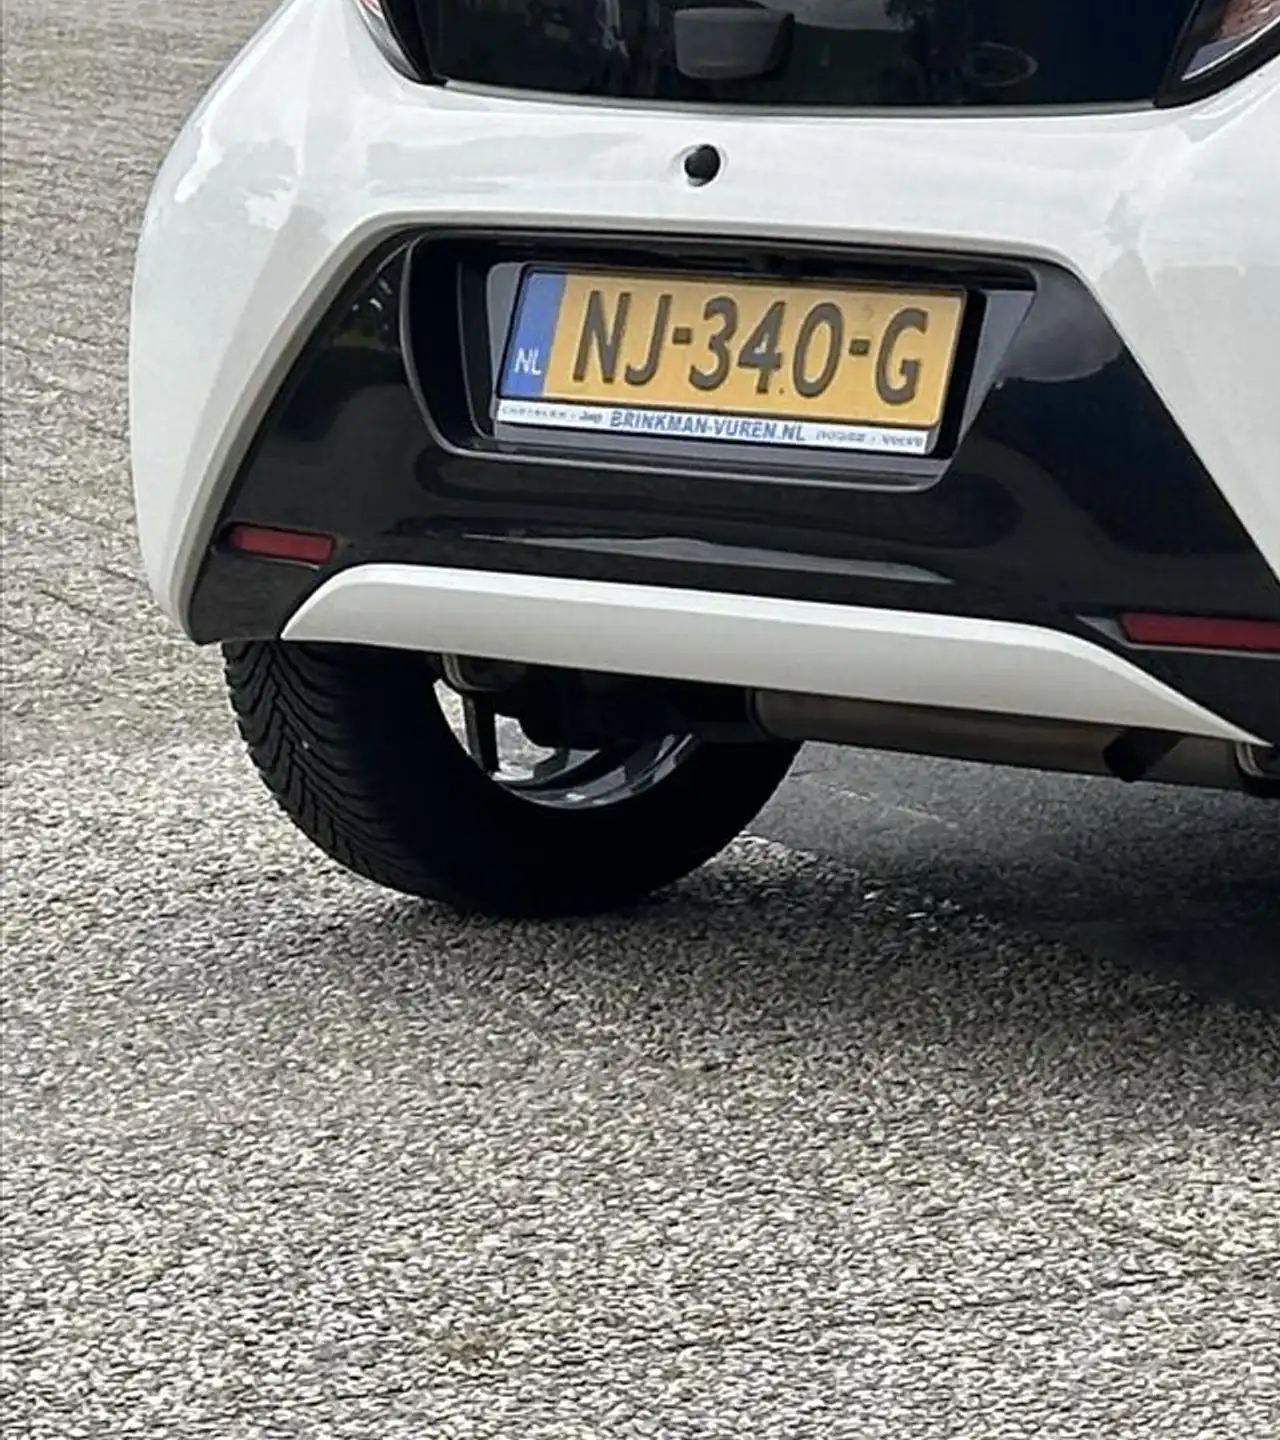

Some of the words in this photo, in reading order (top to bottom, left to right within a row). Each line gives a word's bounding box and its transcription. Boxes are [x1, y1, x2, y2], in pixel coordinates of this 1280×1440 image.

[514, 348, 542, 375] NL
[572, 290, 928, 406] NJ-340-G
[609, 410, 806, 442] BRINKMAN-VUREN.NL
